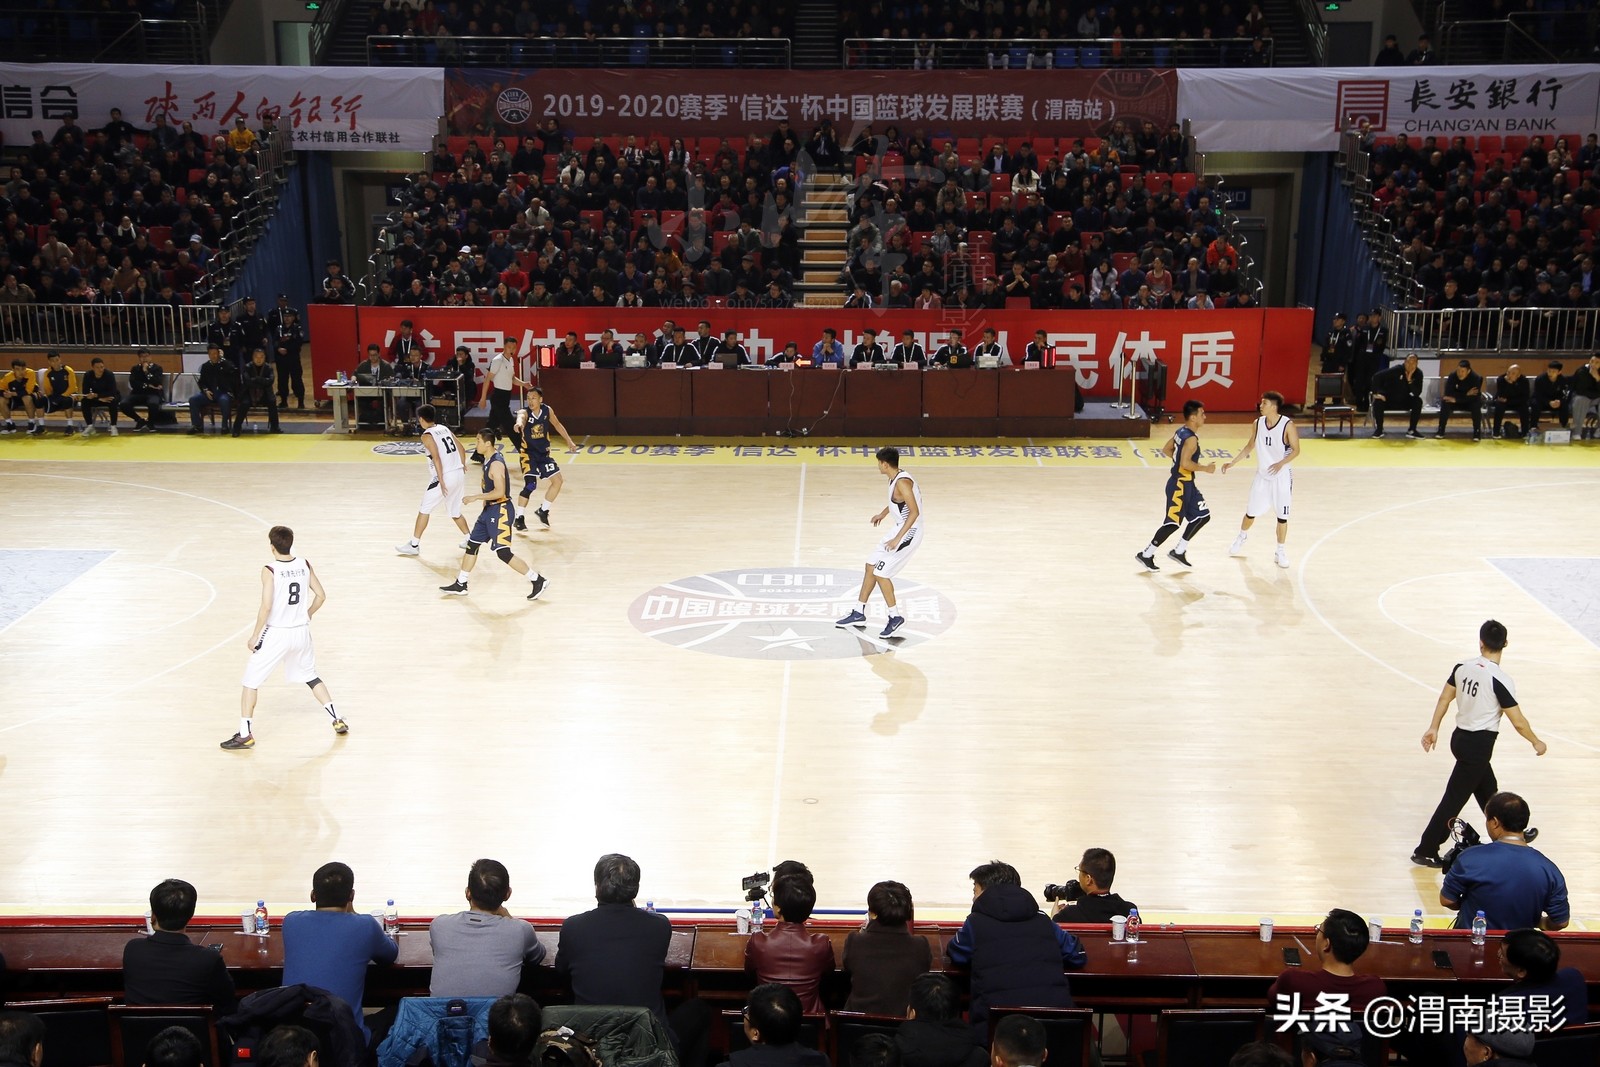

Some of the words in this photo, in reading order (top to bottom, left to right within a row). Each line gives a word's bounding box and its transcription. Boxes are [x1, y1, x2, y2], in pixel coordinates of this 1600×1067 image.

[1404, 118, 1499, 132] CHANG'AN
[1505, 117, 1557, 131] BANK
[441, 436, 457, 454] 13
[1265, 436, 1272, 447] 11
[545, 463, 555, 472] 13
[737, 573, 851, 587] CBDL
[287, 582, 301, 606] 8
[1461, 677, 1479, 698] 116
